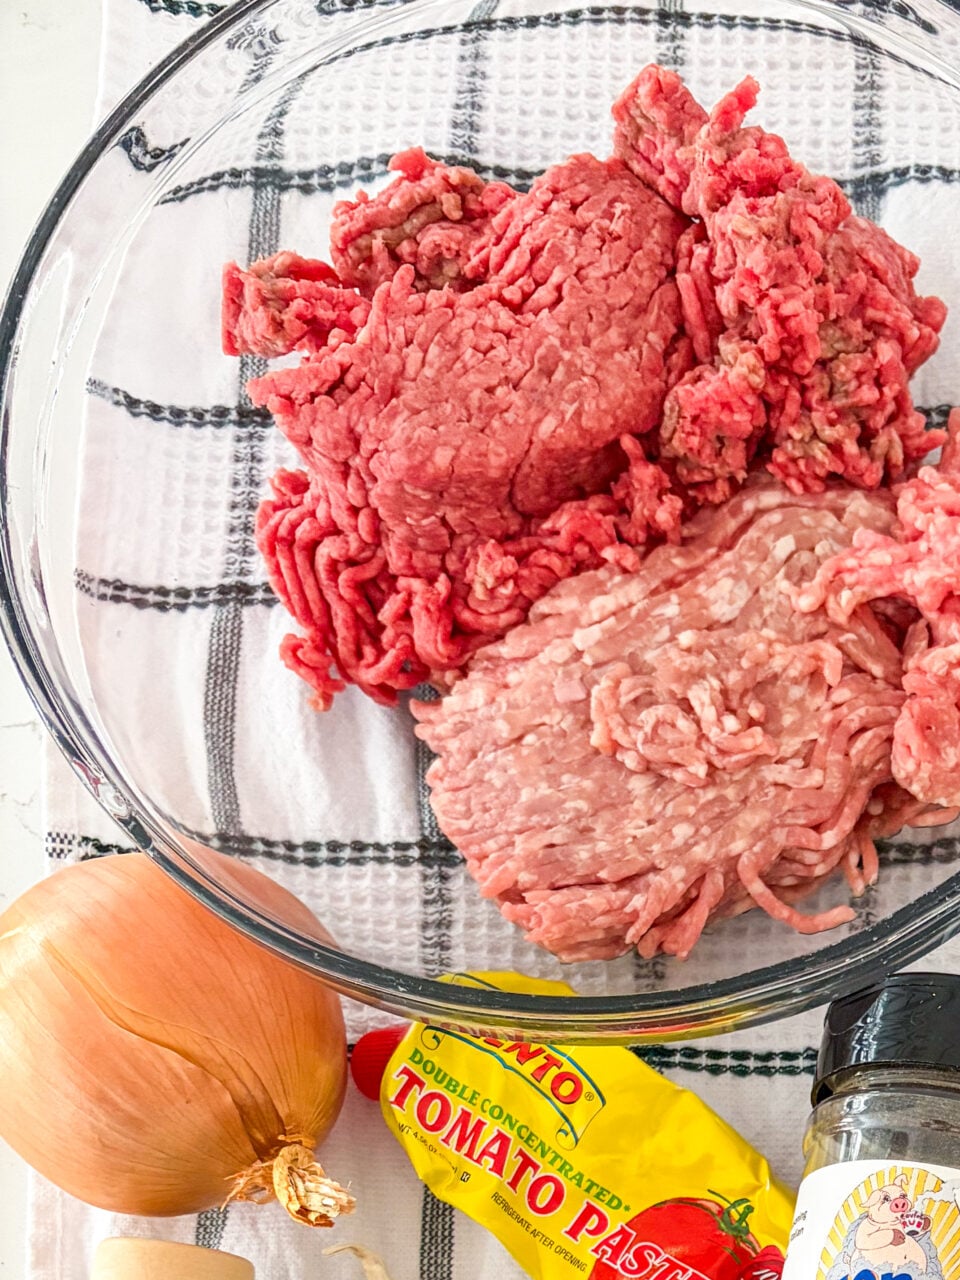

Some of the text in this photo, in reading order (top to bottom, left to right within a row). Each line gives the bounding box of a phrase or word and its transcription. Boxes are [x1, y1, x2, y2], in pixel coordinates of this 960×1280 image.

[408, 1047, 481, 1106] DOUBLE
[390, 1065, 566, 1215] TOMATO
[491, 1191, 531, 1232] REFRIGERATE
[531, 1228, 554, 1250] AFTER
